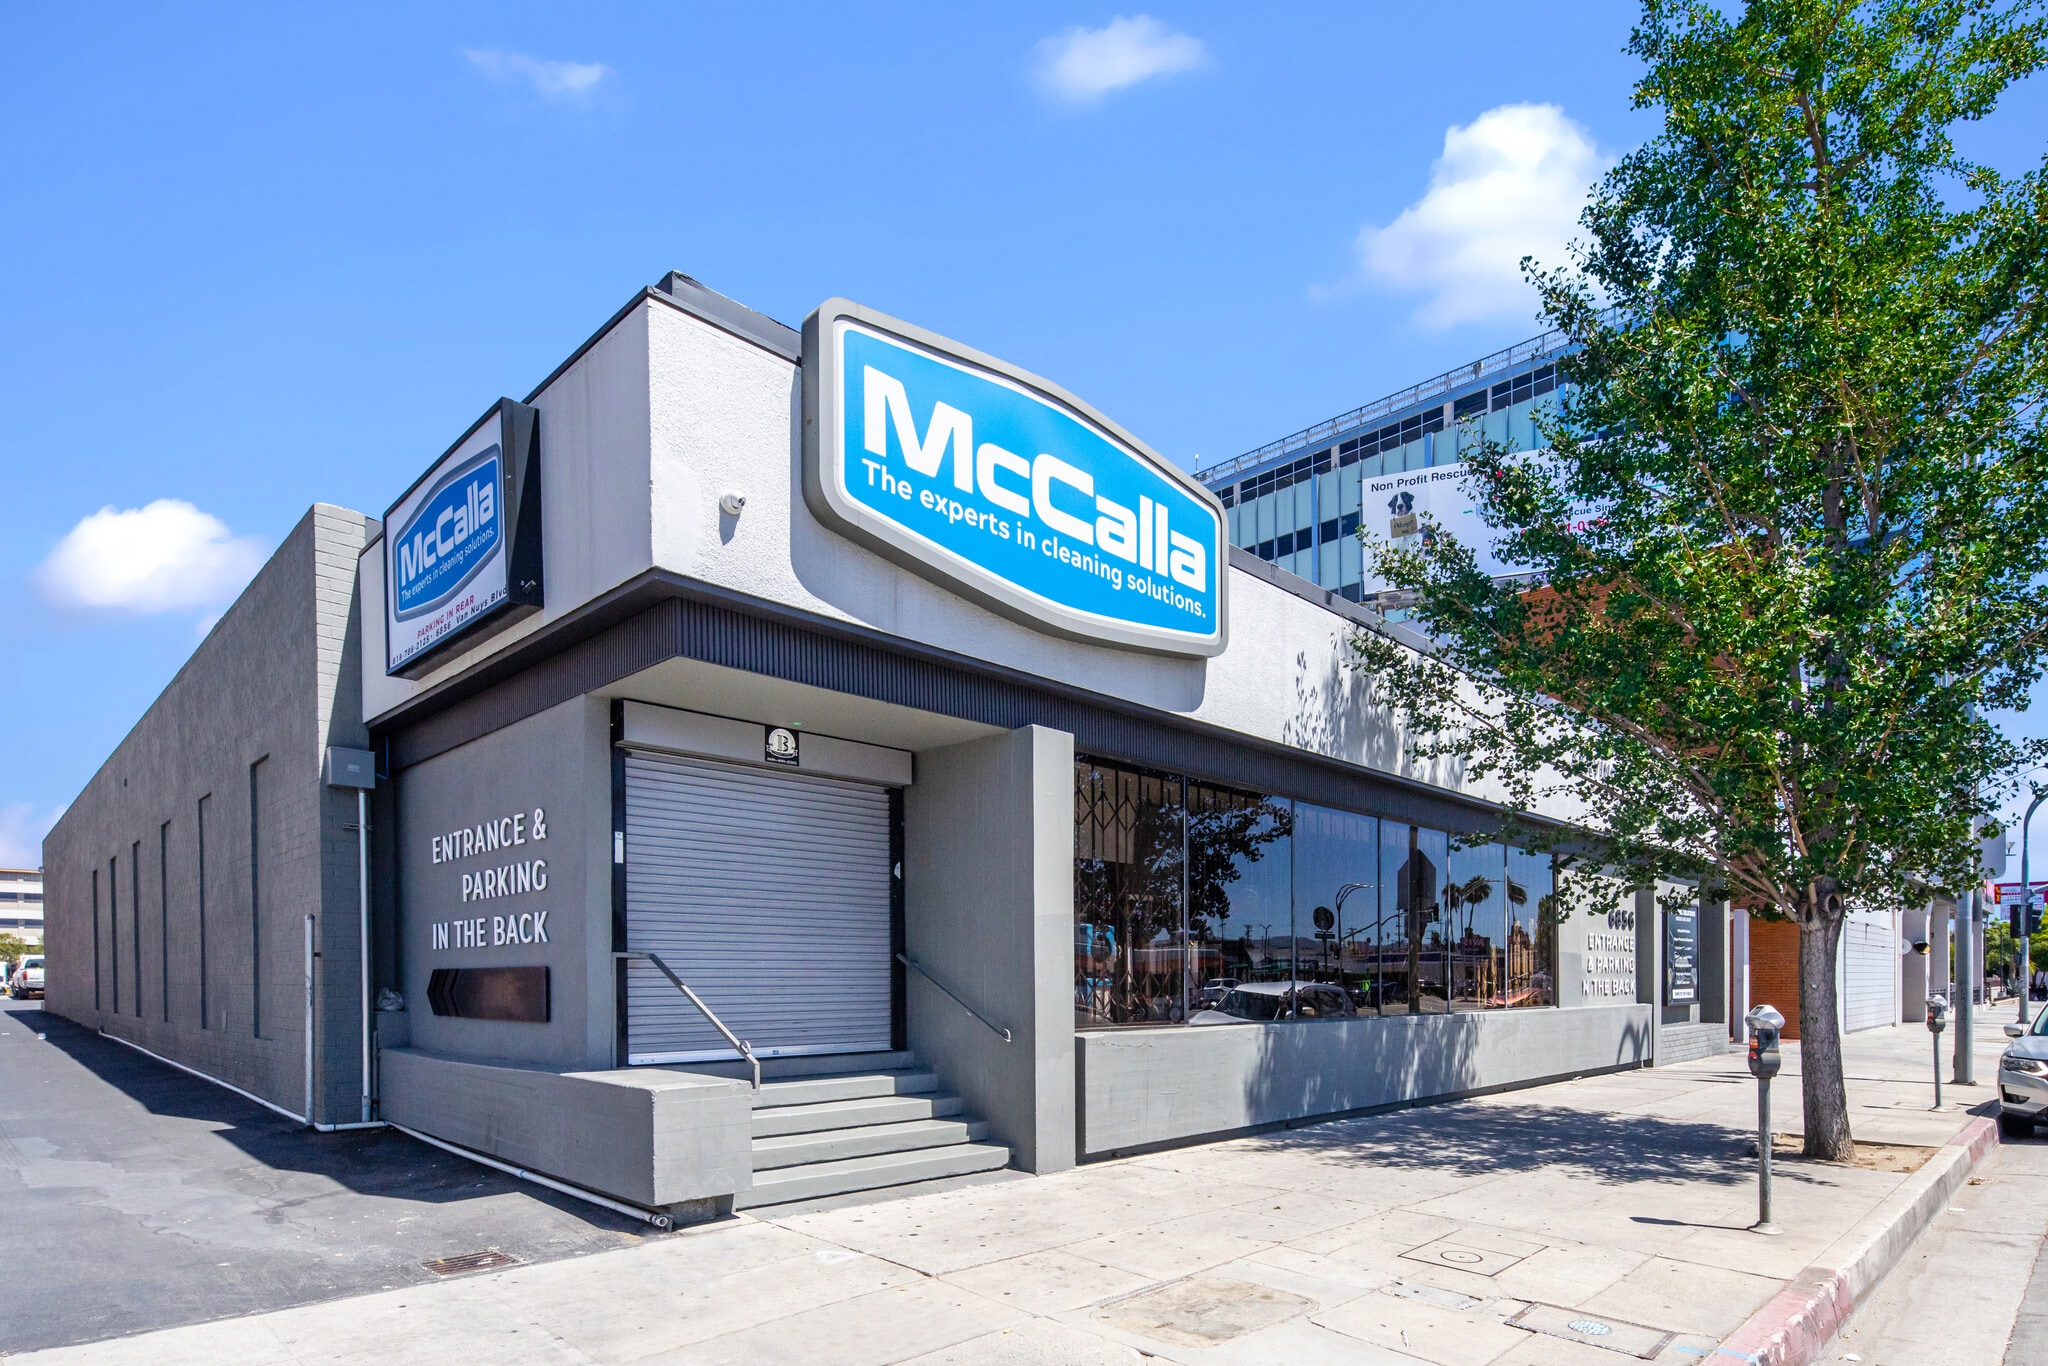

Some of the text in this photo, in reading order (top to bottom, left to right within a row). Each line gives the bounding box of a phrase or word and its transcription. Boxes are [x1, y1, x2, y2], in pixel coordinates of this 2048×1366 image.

[863, 364, 1206, 593] McCalla
[1371, 482, 1393, 492] Non
[1397, 474, 1428, 488] Profit
[400, 480, 495, 587] McCalla
[862, 457, 1207, 619] The experts in cleaning solutions.
[401, 526, 495, 603] The experts in cleaning solutions.
[417, 594, 475, 639] PARKING IN REAR
[456, 611, 469, 624] Van
[470, 599, 488, 614] Nuys
[432, 808, 547, 864] ENTRANCE &
[462, 859, 547, 902] PARKING
[432, 911, 548, 950] IN THE BACK
[1588, 933, 1635, 953] ENTRANCE
[1587, 955, 1635, 974] & PARKING
[1592, 979, 1610, 997] THE
[1612, 979, 1636, 997] BACK
